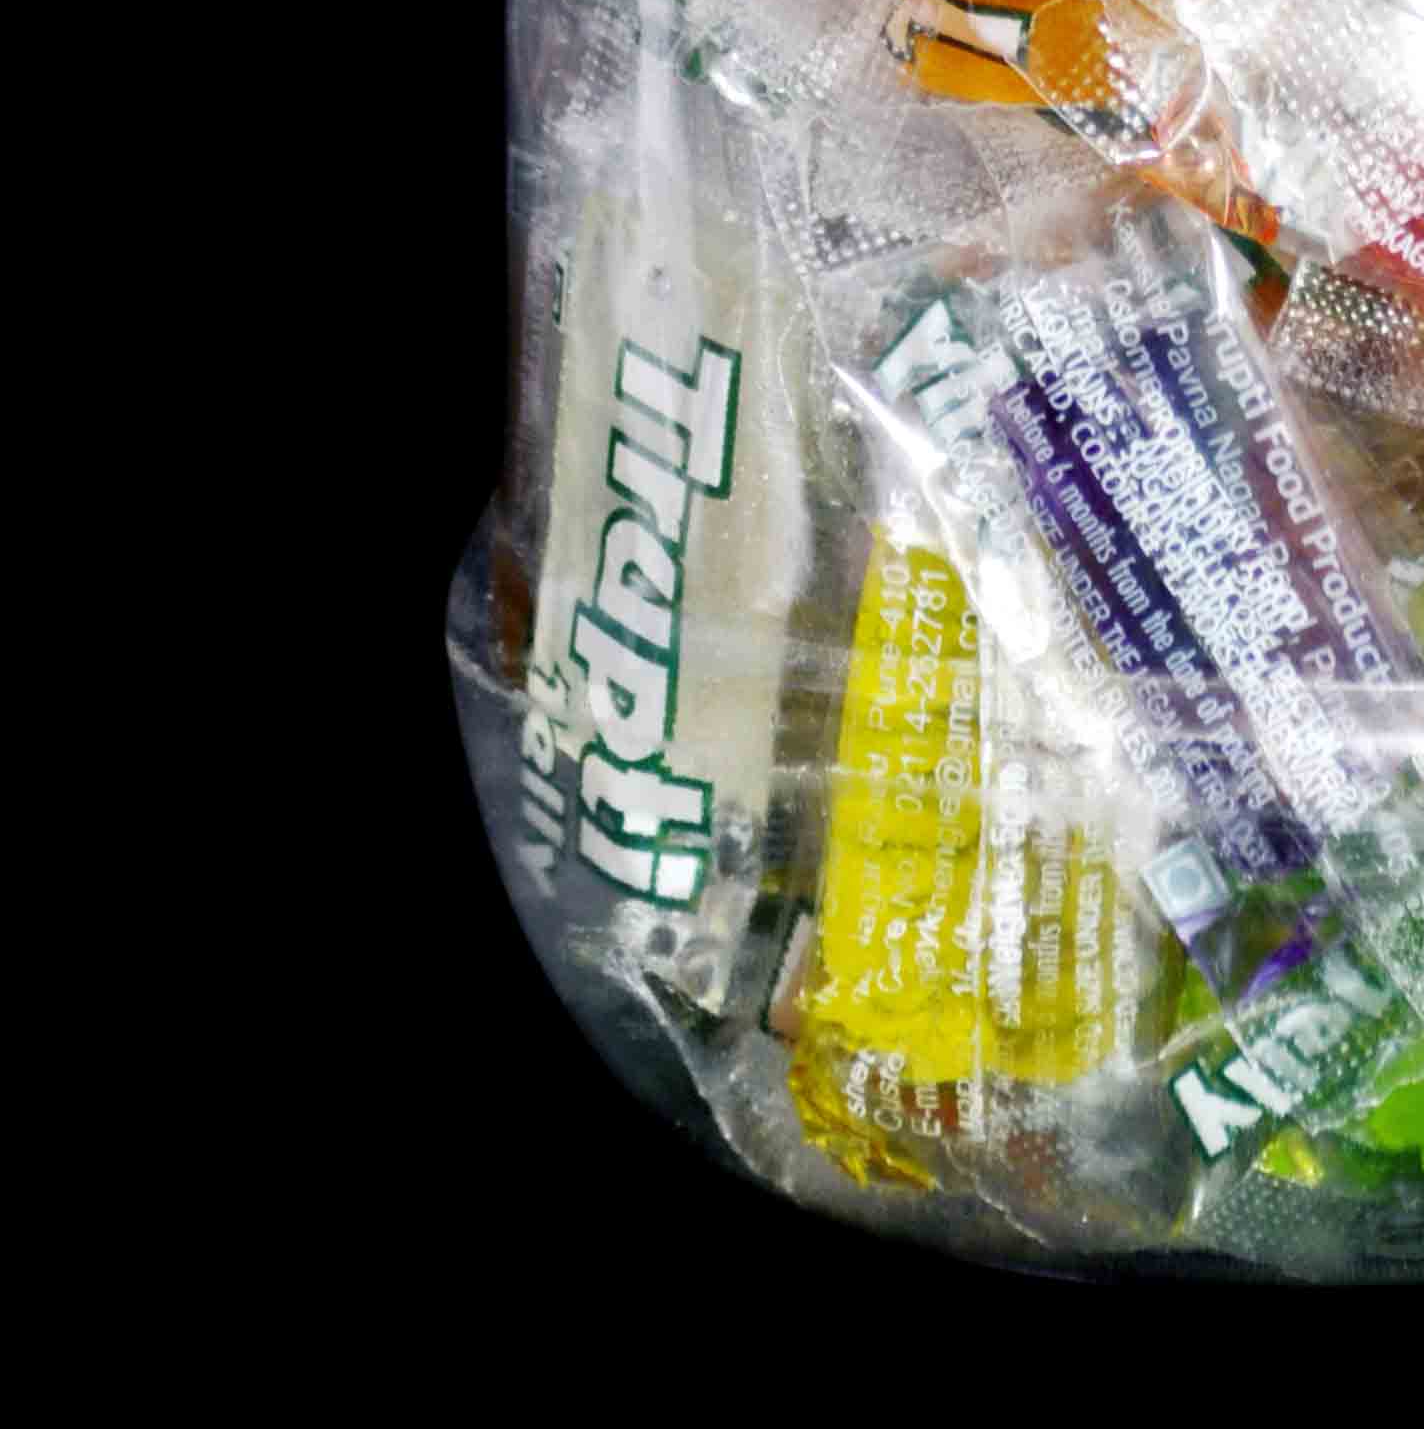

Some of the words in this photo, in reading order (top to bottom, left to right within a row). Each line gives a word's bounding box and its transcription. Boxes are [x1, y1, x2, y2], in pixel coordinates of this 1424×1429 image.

[1021, 345, 1081, 425] ACID,
[1146, 313, 1235, 431] Pavna
[1002, 387, 1067, 467] before
[1042, 457, 1077, 487] 6
[1184, 300, 1278, 425] rupti
[1243, 416, 1331, 528] Food
[1288, 521, 1414, 700] Product
[1054, 476, 1127, 568] months
[565, 337, 743, 913] Trupti
[1105, 552, 1163, 618] from
[1095, 620, 1142, 675] THE
[1138, 605, 1185, 654] the
